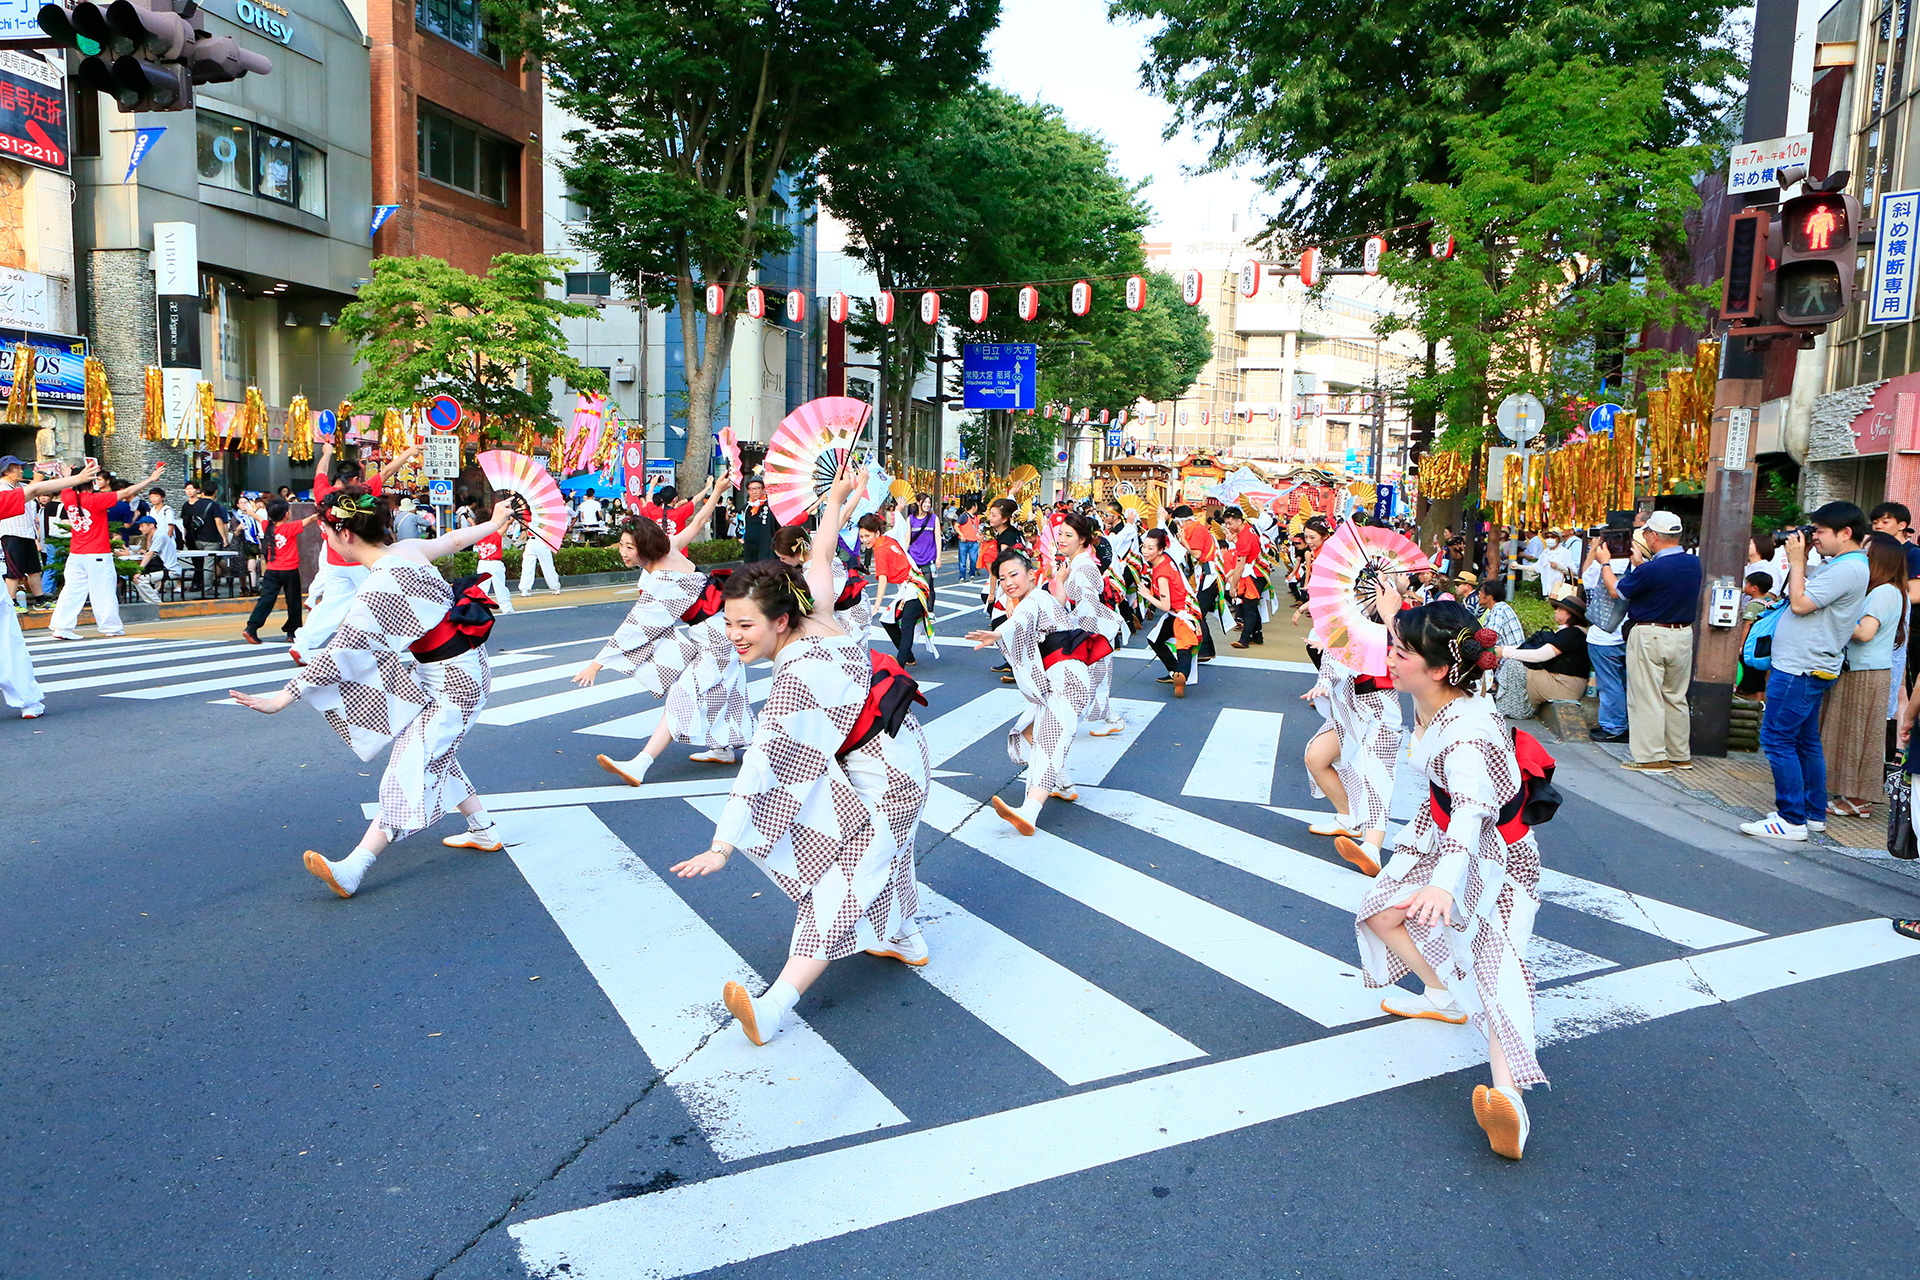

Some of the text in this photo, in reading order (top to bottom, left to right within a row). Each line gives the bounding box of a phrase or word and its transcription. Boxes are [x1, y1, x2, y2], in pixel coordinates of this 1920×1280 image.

[15, 17, 40, 30] 1-ch
[237, 0, 294, 45] Ottsy
[0, 80, 62, 127] 信号左折
[0, 135, 59, 164] 31-2211
[131, 134, 149, 166] Ottsy
[1732, 162, 1805, 187] 斜め横
[164, 229, 177, 285] ALBION
[1881, 201, 1912, 313] 斜め横断専用
[72, 346, 82, 355] 3F
[982, 345, 1000, 355] 日立
[1013, 345, 1032, 355] 大洗
[965, 370, 1011, 380] 常陸大宮 那珂
[172, 377, 182, 432] IGNIS
